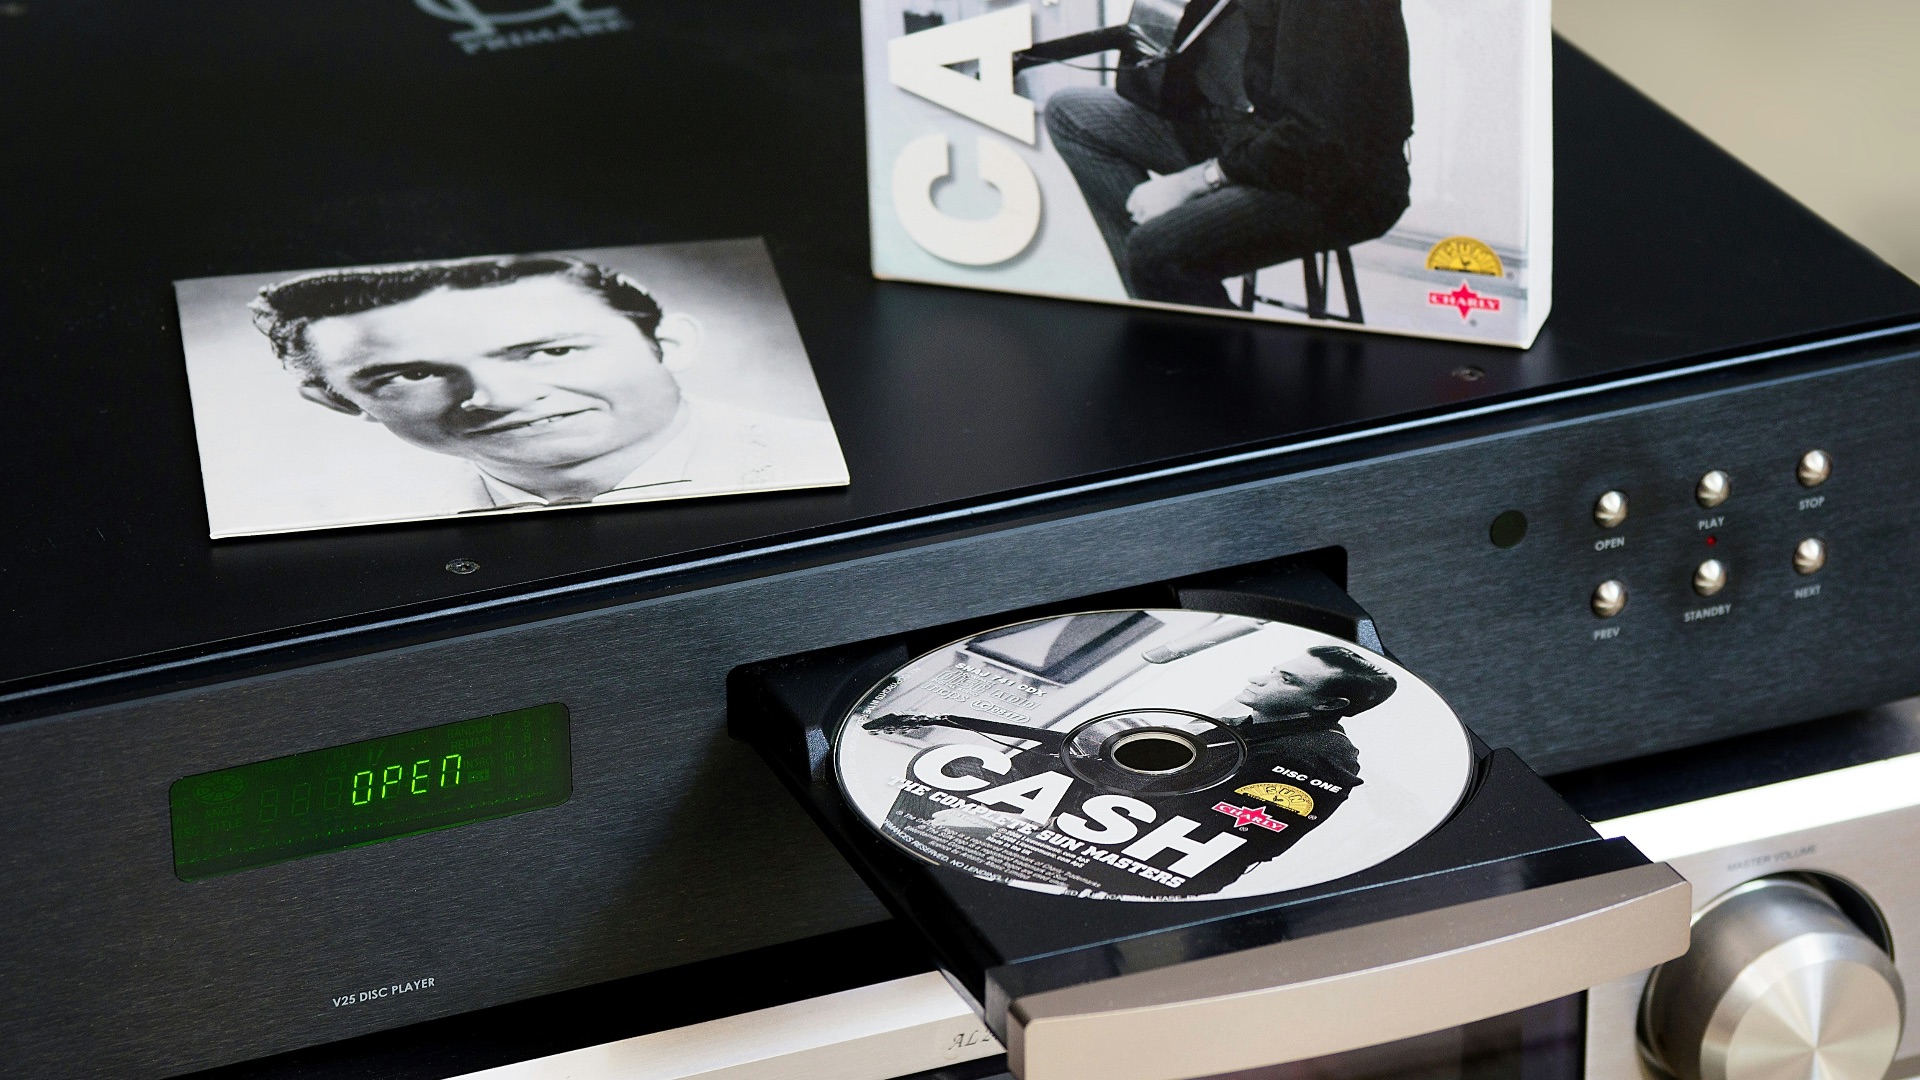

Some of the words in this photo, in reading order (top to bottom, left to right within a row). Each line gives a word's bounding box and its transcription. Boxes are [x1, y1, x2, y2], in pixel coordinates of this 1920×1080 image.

[888, 0, 1040, 265] CA
[1799, 496, 1825, 511] STOP
[1698, 517, 1725, 531] PLAY
[1595, 537, 1625, 552] OPEN
[1794, 585, 1822, 599] NEXT
[1684, 604, 1732, 622] STANDBY
[1593, 627, 1621, 641] PREV
[955, 662, 991, 677] SNAJ
[1017, 684, 1047, 697] CDX
[352, 754, 462, 805] OPEN
[1271, 765, 1308, 782] DISC
[1309, 778, 1342, 794] ONE
[1265, 785, 1306, 804] SUN
[913, 744, 1247, 878] CASH
[1219, 806, 1284, 830] CHARLY
[887, 776, 932, 797] THE
[929, 791, 1039, 835] COMPLETE
[1036, 829, 1085, 851] SUN
[1081, 846, 1186, 888] MASTERS
[332, 995, 356, 1008] V25
[360, 988, 388, 1002] DISC
[391, 978, 435, 996] PLAYER
